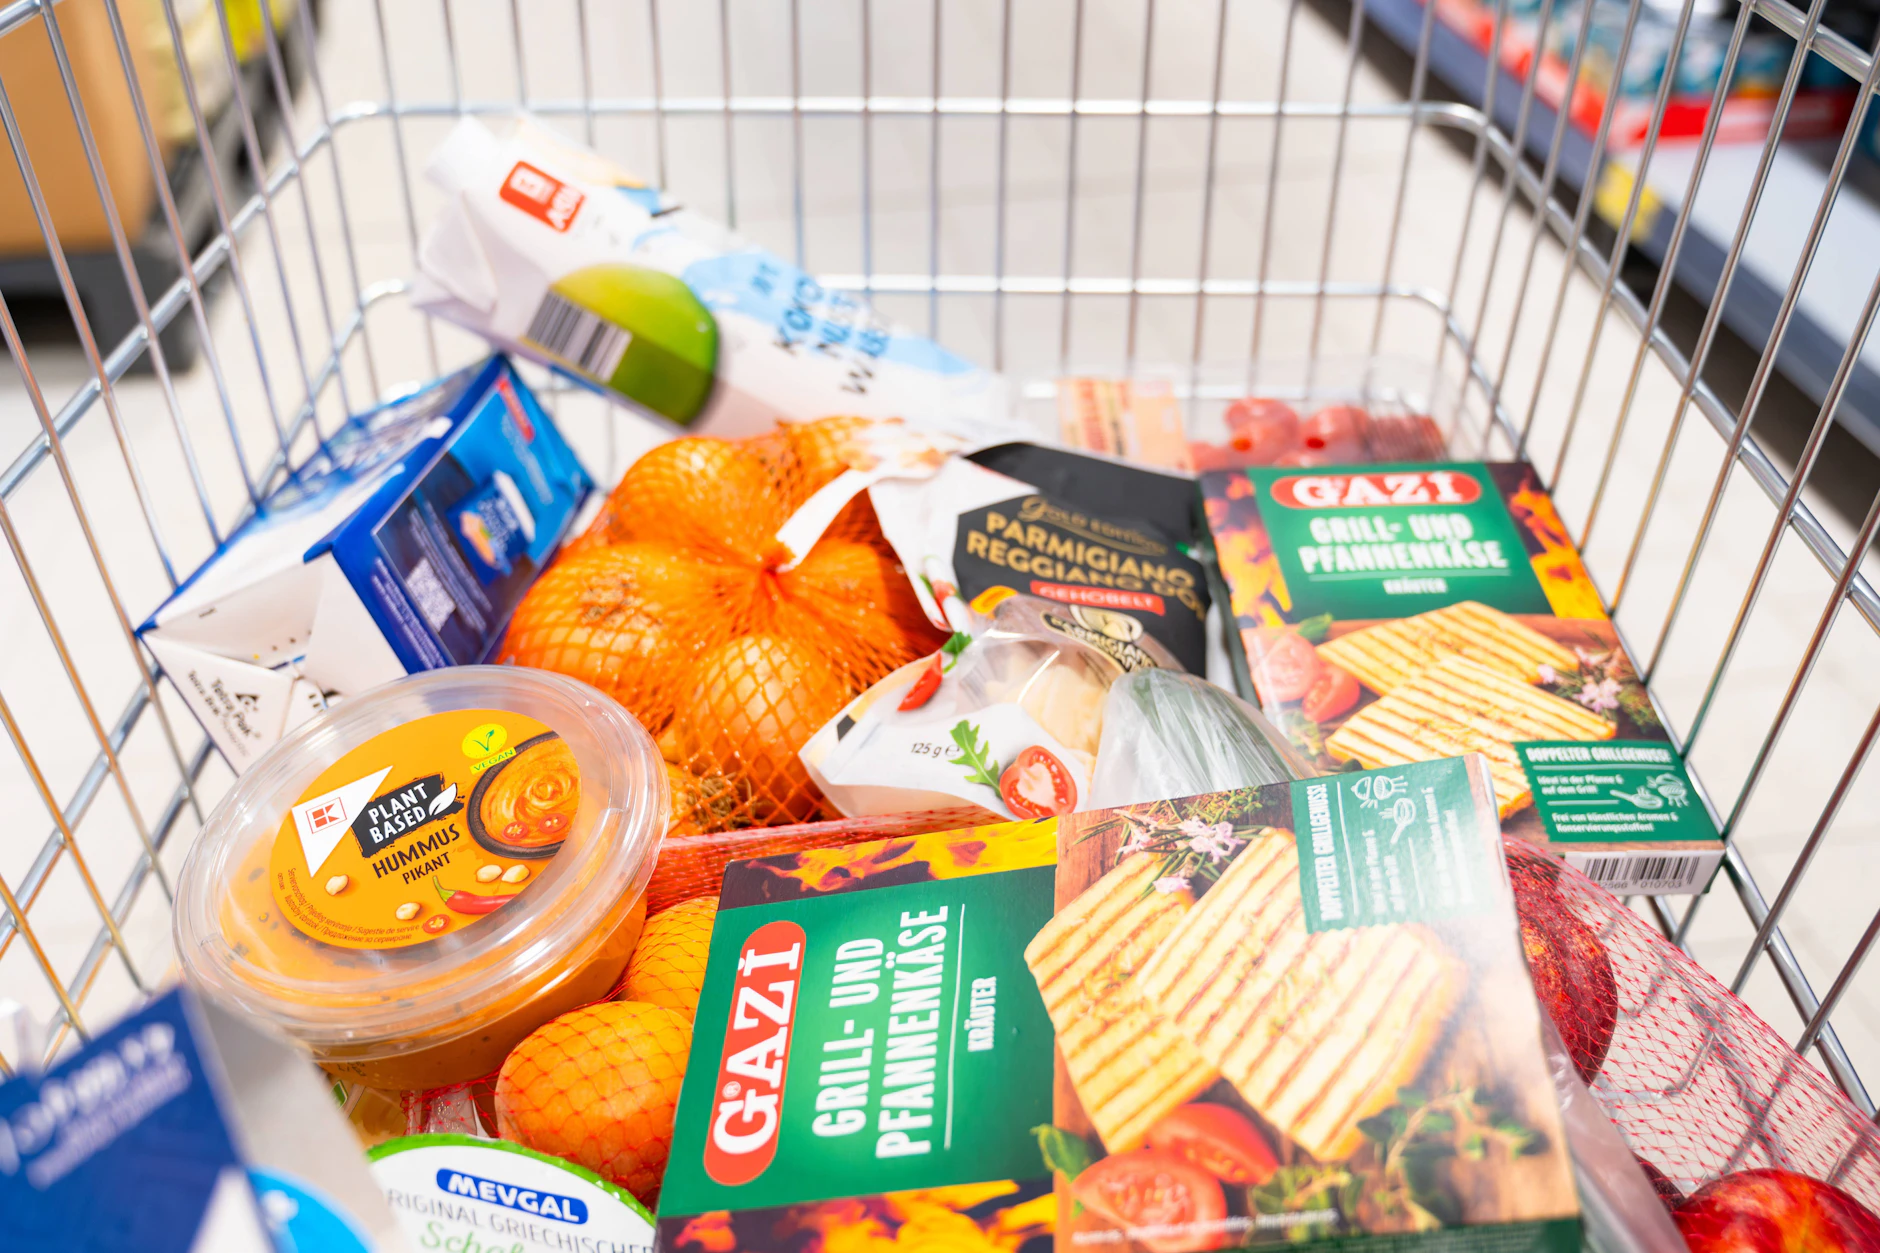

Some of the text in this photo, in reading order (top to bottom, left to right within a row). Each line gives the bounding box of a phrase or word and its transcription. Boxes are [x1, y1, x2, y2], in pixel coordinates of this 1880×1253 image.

[1309, 513, 1475, 544] GRILL- UND
[966, 530, 1143, 591] REGGIANO
[986, 511, 1195, 589] PARMIGIANO
[1298, 538, 1509, 574] PFANNENKÄSE
[1038, 584, 1154, 608] GEHOBELT
[1383, 577, 1447, 595] KRÄUTER
[473, 749, 514, 771] VEGAN
[911, 742, 932, 754] 125
[932, 746, 942, 758] g
[1525, 747, 1591, 762] DOPPELTER
[1541, 785, 1556, 795] auf
[1556, 785, 1576, 795] dem
[1569, 775, 1584, 785] der
[1585, 774, 1615, 785] Pfanne
[367, 782, 428, 825] PLANT
[1551, 812, 1569, 823] Frei
[1569, 814, 1586, 823] von
[1586, 812, 1636, 823] künstlichen
[1637, 812, 1670, 823] Aromen
[368, 805, 427, 844] BASED
[372, 823, 460, 879] HUMMUS
[402, 851, 450, 885] PIKANT
[1640, 881, 1682, 890] 010703
[356, 926, 385, 936] Sugestie
[386, 927, 395, 935] de
[396, 924, 420, 933] servire
[964, 976, 997, 1052] KRÄUTER
[812, 938, 884, 1137] GRILL- UND
[874, 904, 949, 1159] PFANNENKÄSE
[387, 1187, 485, 1228] RIGINAL
[447, 1172, 580, 1223] MEVGAL
